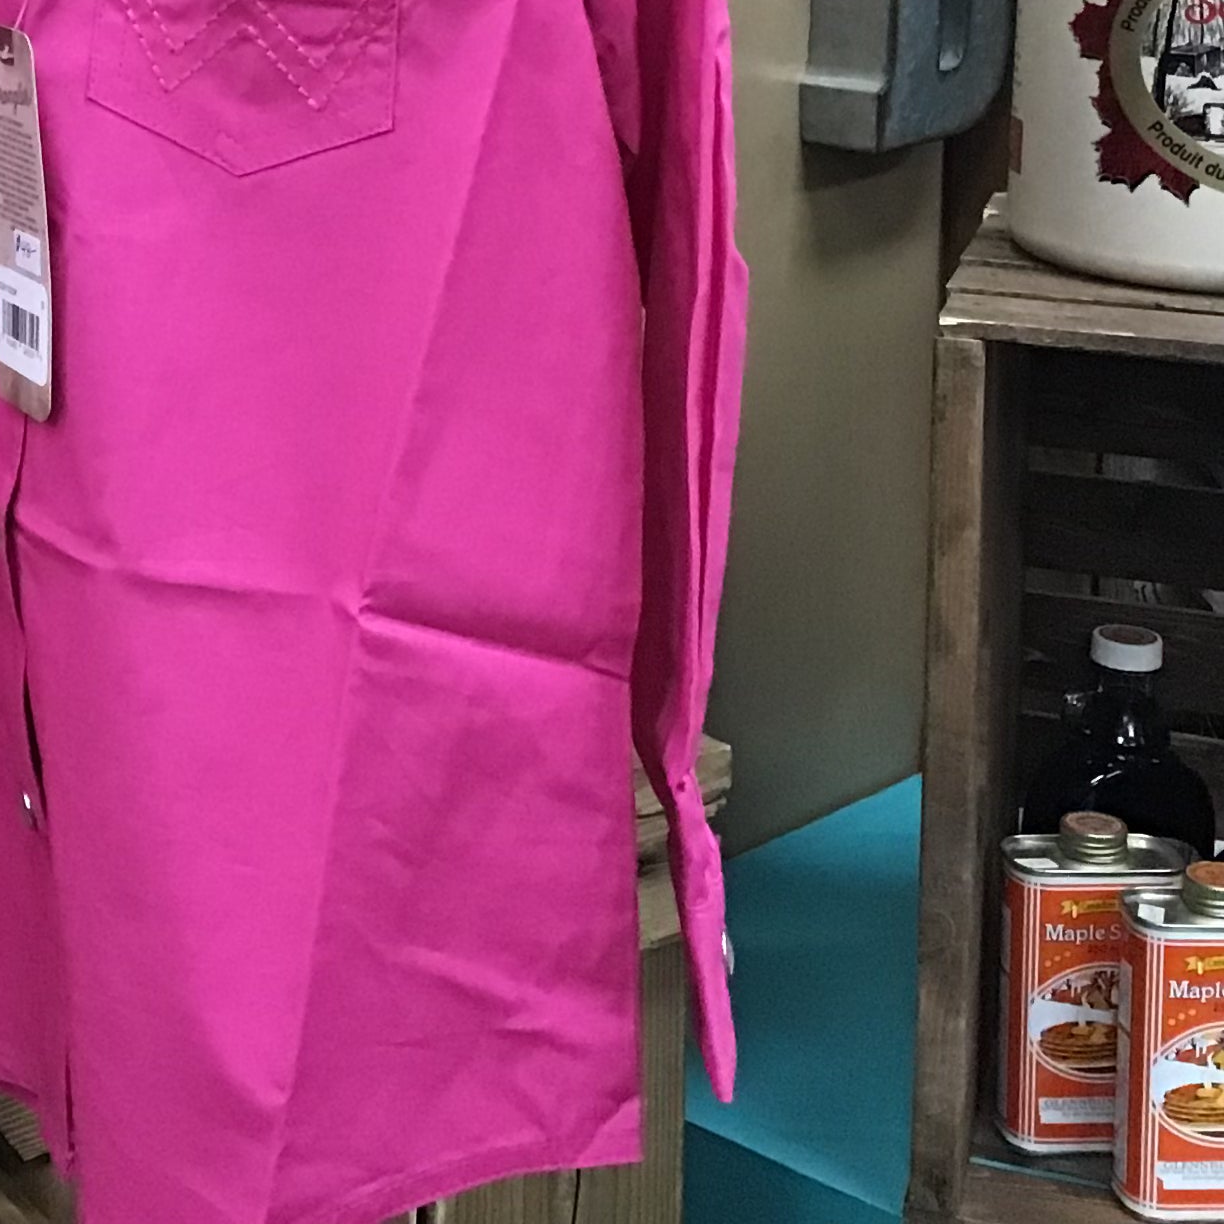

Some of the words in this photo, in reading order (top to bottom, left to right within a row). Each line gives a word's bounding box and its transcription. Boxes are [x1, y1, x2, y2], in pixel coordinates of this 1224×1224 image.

[1147, 120, 1204, 169] Produit
[1045, 923, 1106, 945] Maple
[1169, 980, 1224, 1004] Mapl
